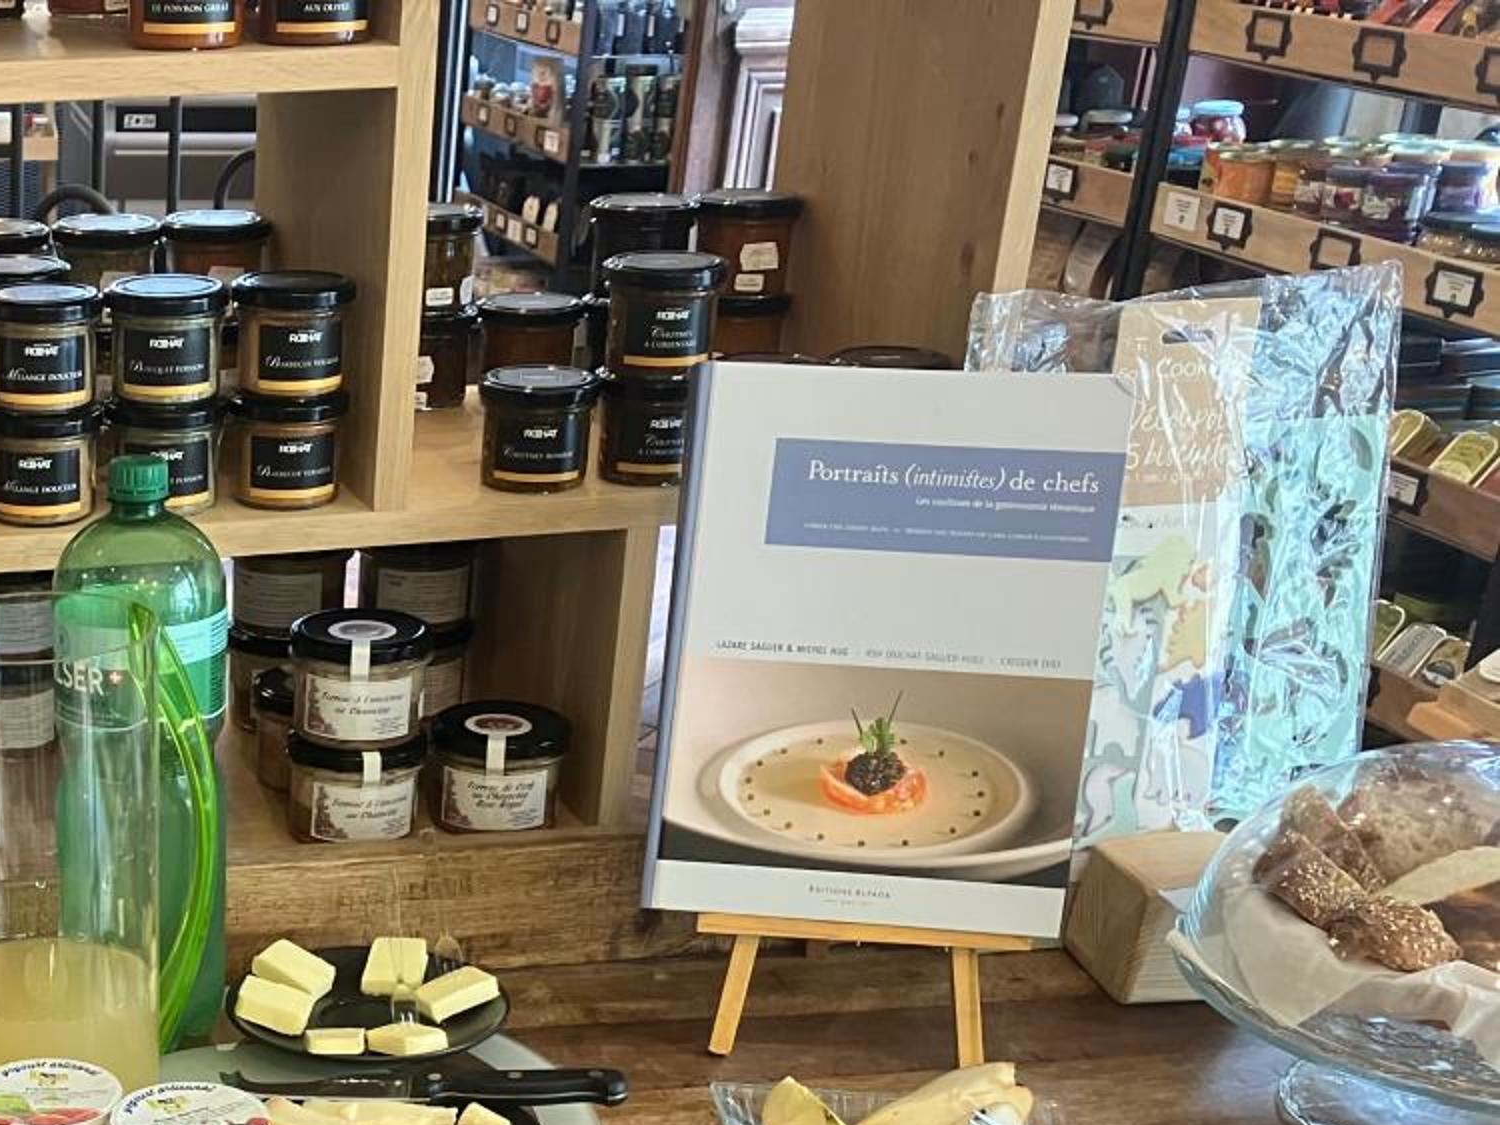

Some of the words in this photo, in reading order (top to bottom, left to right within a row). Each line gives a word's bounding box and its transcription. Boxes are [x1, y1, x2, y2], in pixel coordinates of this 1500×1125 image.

[807, 459, 900, 486] Portraits
[904, 463, 1007, 492] (intimistes)
[1009, 470, 1036, 491] de
[1043, 471, 1100, 495] chefs
